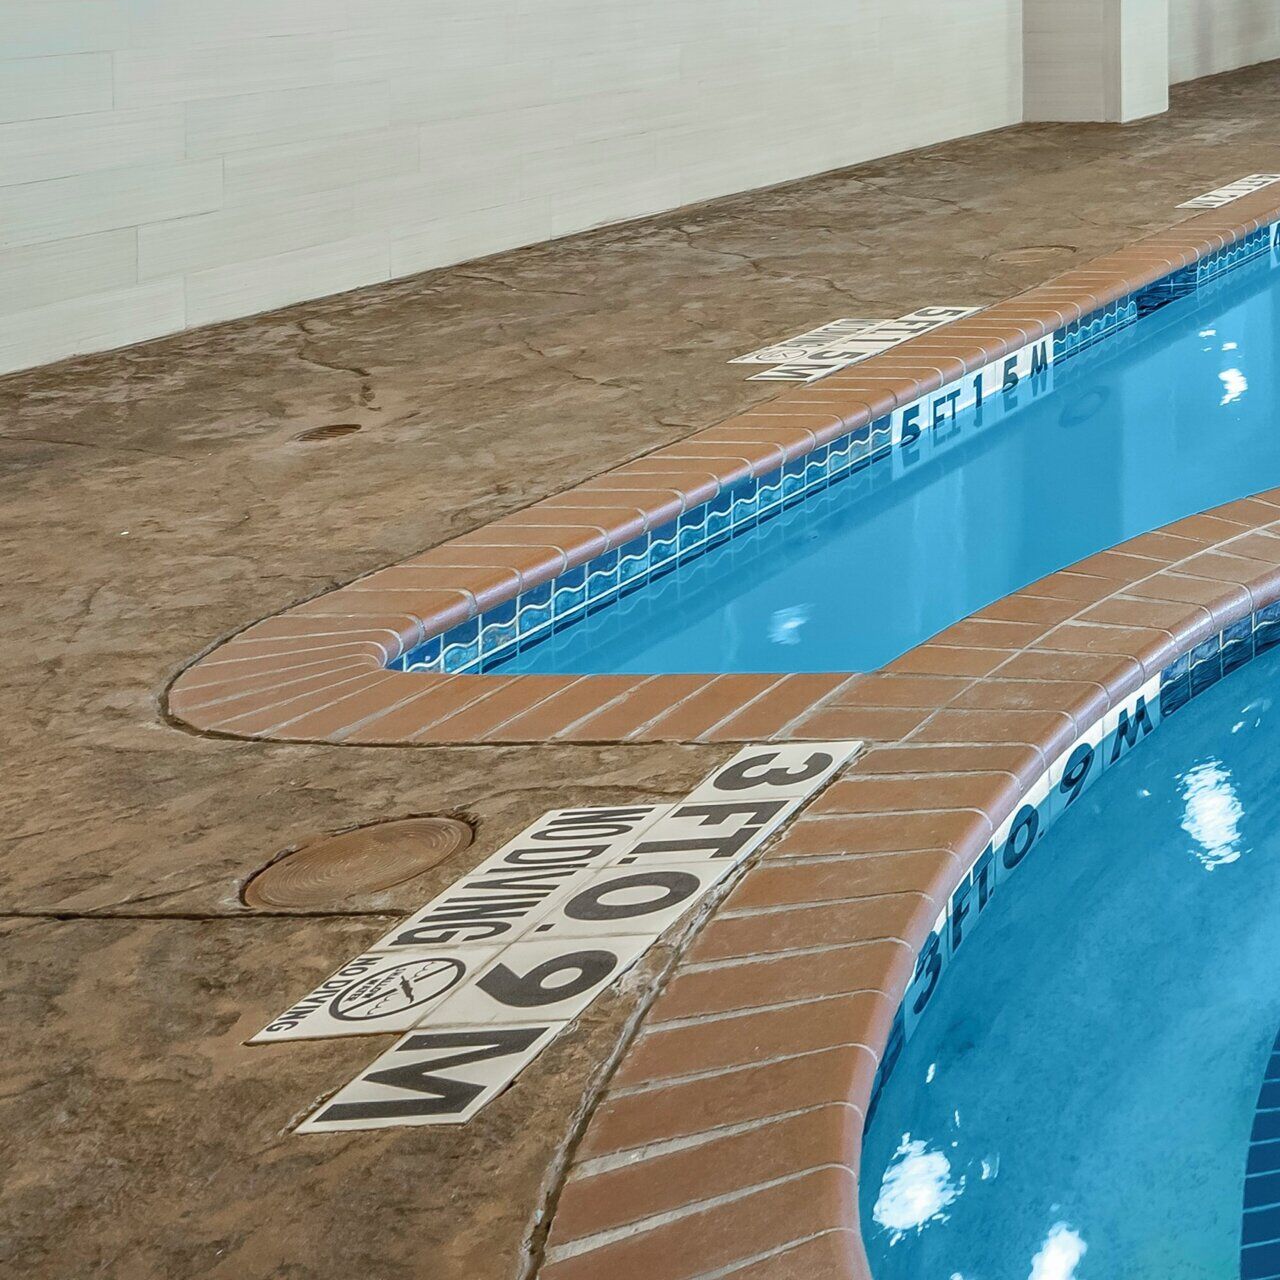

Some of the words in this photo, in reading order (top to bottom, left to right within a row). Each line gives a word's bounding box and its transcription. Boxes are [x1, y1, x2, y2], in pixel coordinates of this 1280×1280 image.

[914, 308, 967, 318] 5
[755, 364, 837, 380] M
[899, 405, 922, 448] 5
[933, 389, 961, 430] FT
[1030, 341, 1049, 378] M
[712, 751, 834, 792] 3
[530, 807, 657, 841] NO
[913, 929, 942, 1014] 3
[1109, 694, 1154, 765] M
[388, 844, 613, 947] DIVING
[338, 956, 384, 977] NO
[265, 979, 356, 1032] DIVING
[311, 1026, 551, 1123] M
